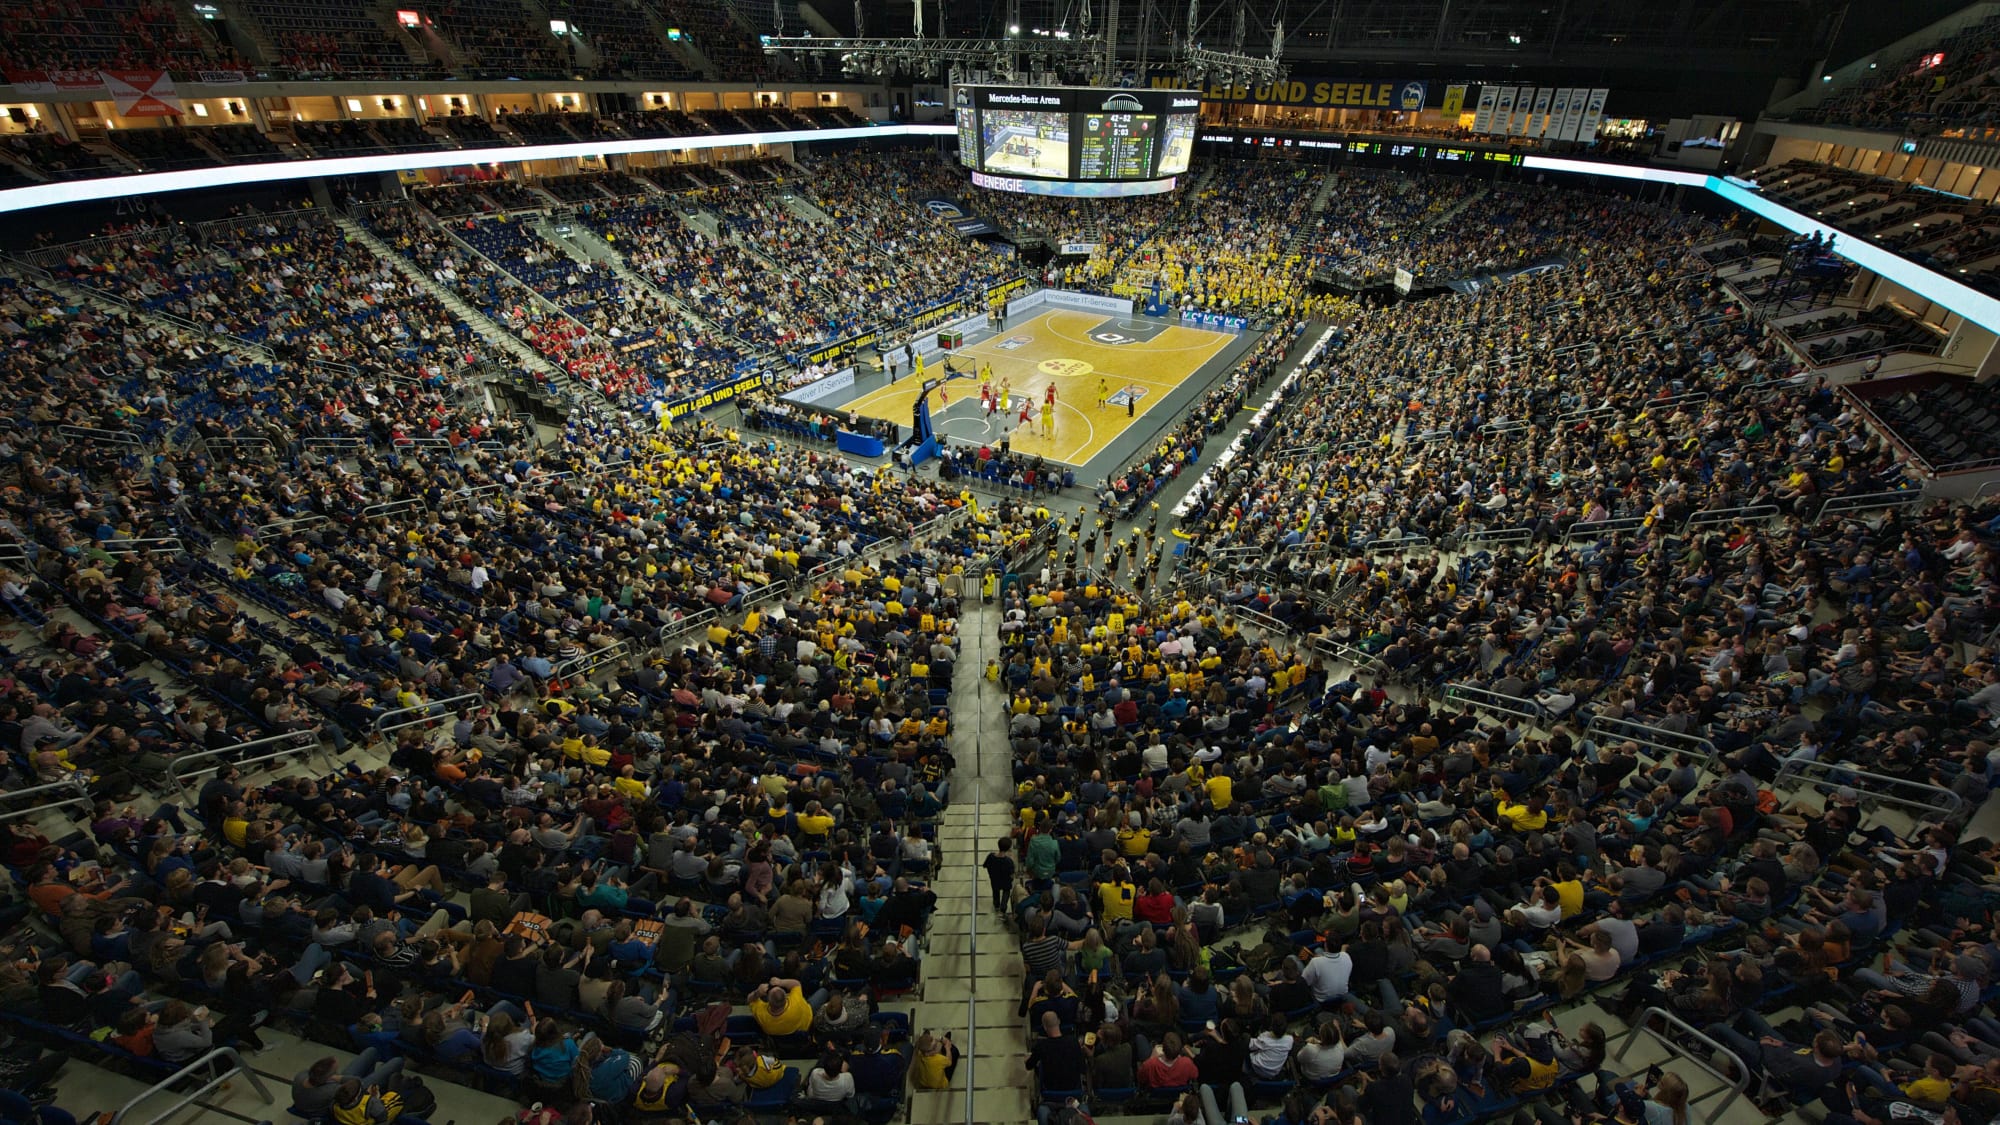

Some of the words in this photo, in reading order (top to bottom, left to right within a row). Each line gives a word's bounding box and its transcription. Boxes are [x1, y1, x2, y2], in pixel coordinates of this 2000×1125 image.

[989, 93, 1038, 104] Mercedes-Benz
[1040, 95, 1061, 105] Arena
[1254, 82, 1305, 103] UND
[1313, 82, 1393, 106] SEELE
[984, 174, 1026, 193] ENERGIE.
[112, 195, 147, 216] 218
[1081, 296, 1117, 308] IT-Services
[824, 346, 840, 360] LEIB
[818, 373, 853, 393] IT-Services
[670, 403, 688, 417] MIT
[690, 394, 712, 411] LEIB
[713, 386, 733, 402] UND
[734, 376, 762, 394] SEELE
[1127, 665, 1134, 676] 6
